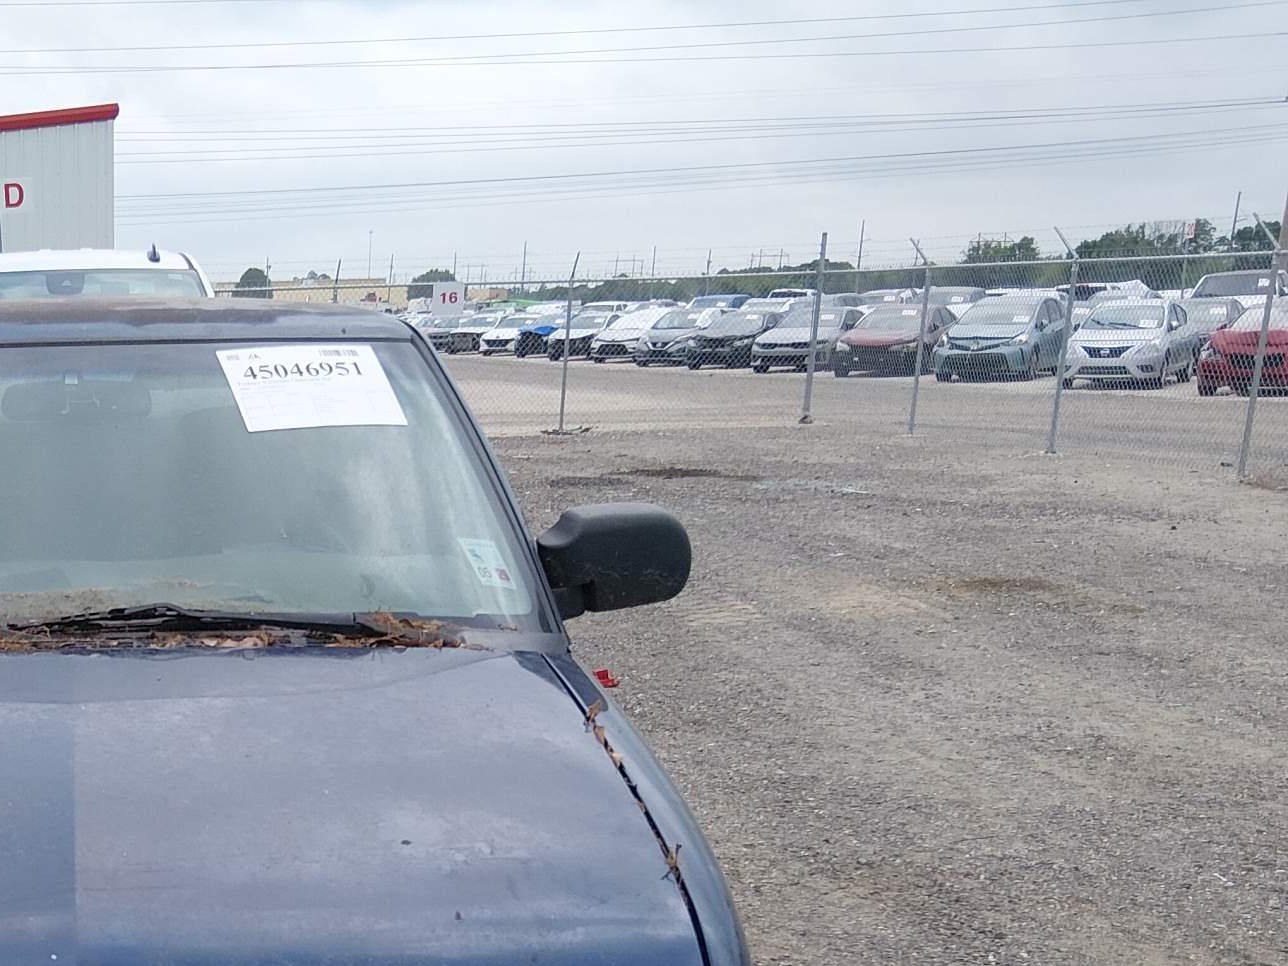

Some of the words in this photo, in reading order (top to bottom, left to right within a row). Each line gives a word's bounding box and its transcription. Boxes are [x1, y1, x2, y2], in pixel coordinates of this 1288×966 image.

[4, 182, 24, 209] D
[439, 291, 458, 304] 16
[243, 361, 363, 380] 45046951
